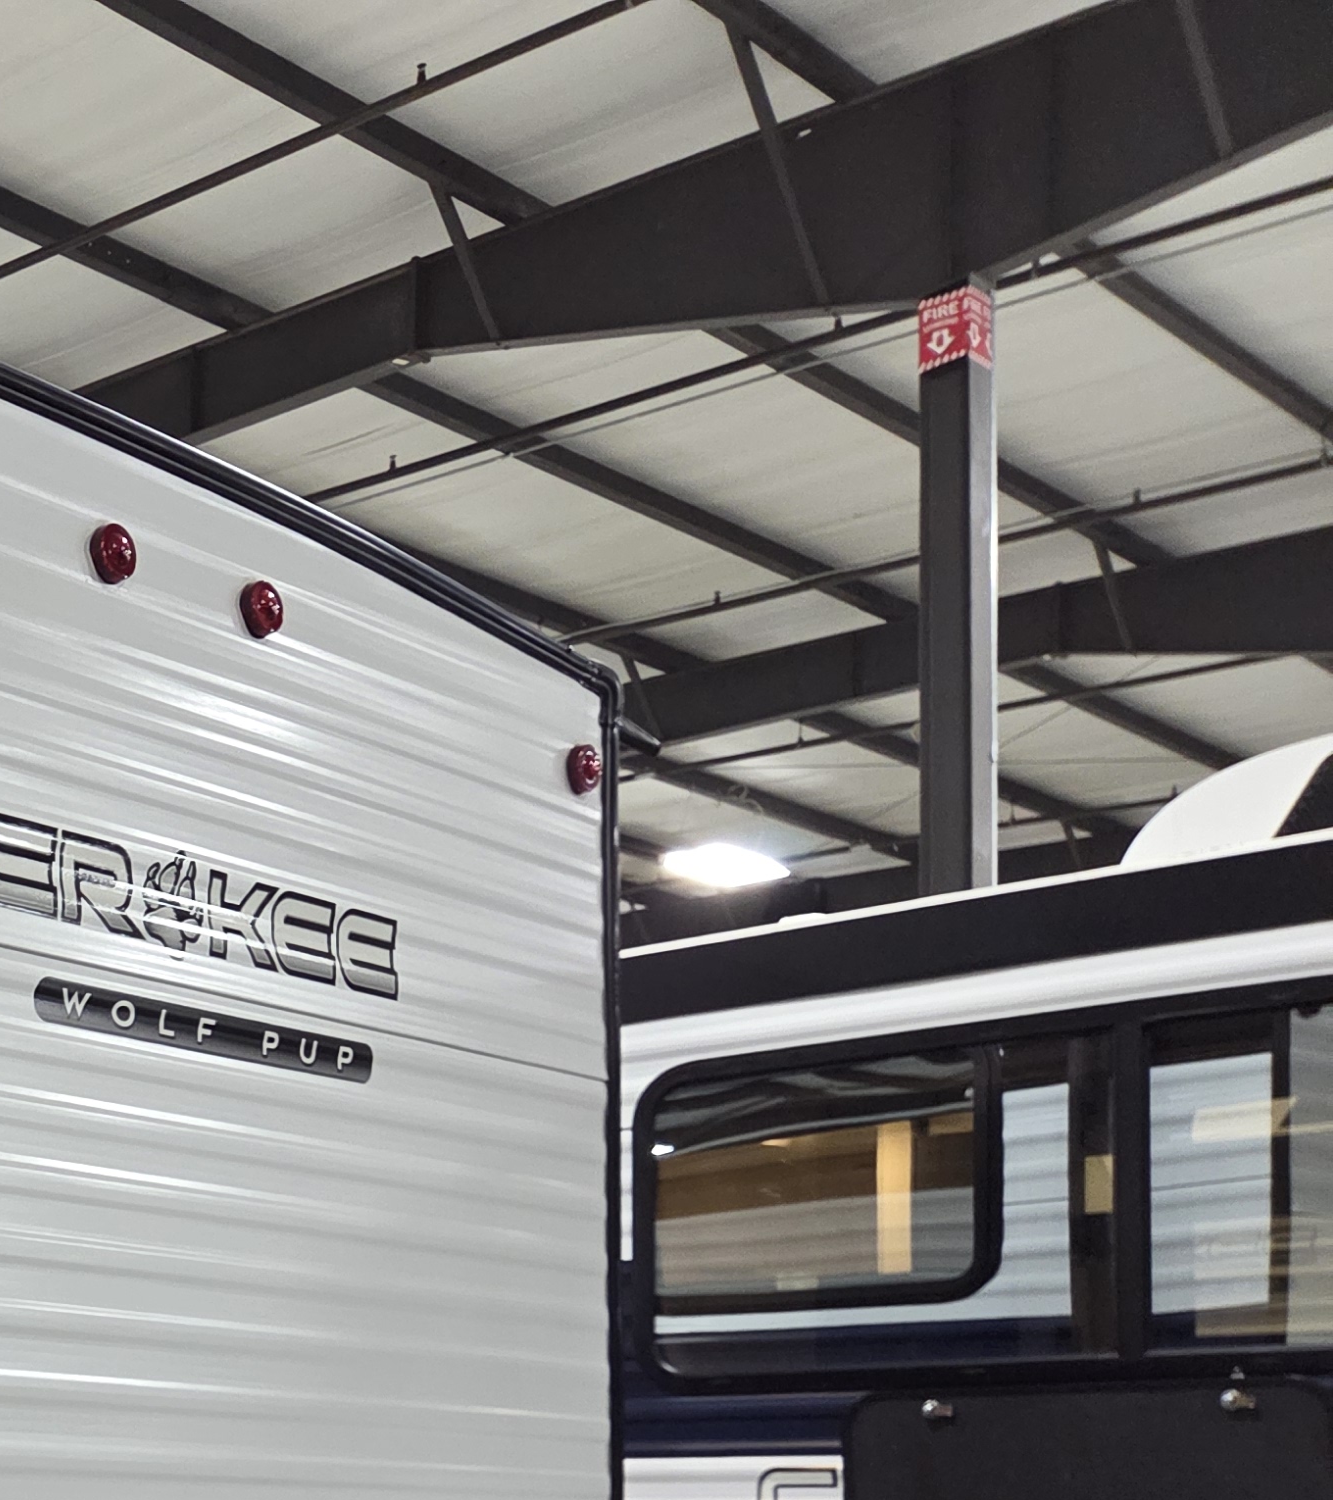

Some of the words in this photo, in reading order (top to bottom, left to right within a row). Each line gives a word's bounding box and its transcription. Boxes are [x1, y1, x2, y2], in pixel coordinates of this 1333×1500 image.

[922, 301, 959, 323] FIRE
[61, 986, 217, 1044] WOLF
[262, 1030, 354, 1071] PUP
